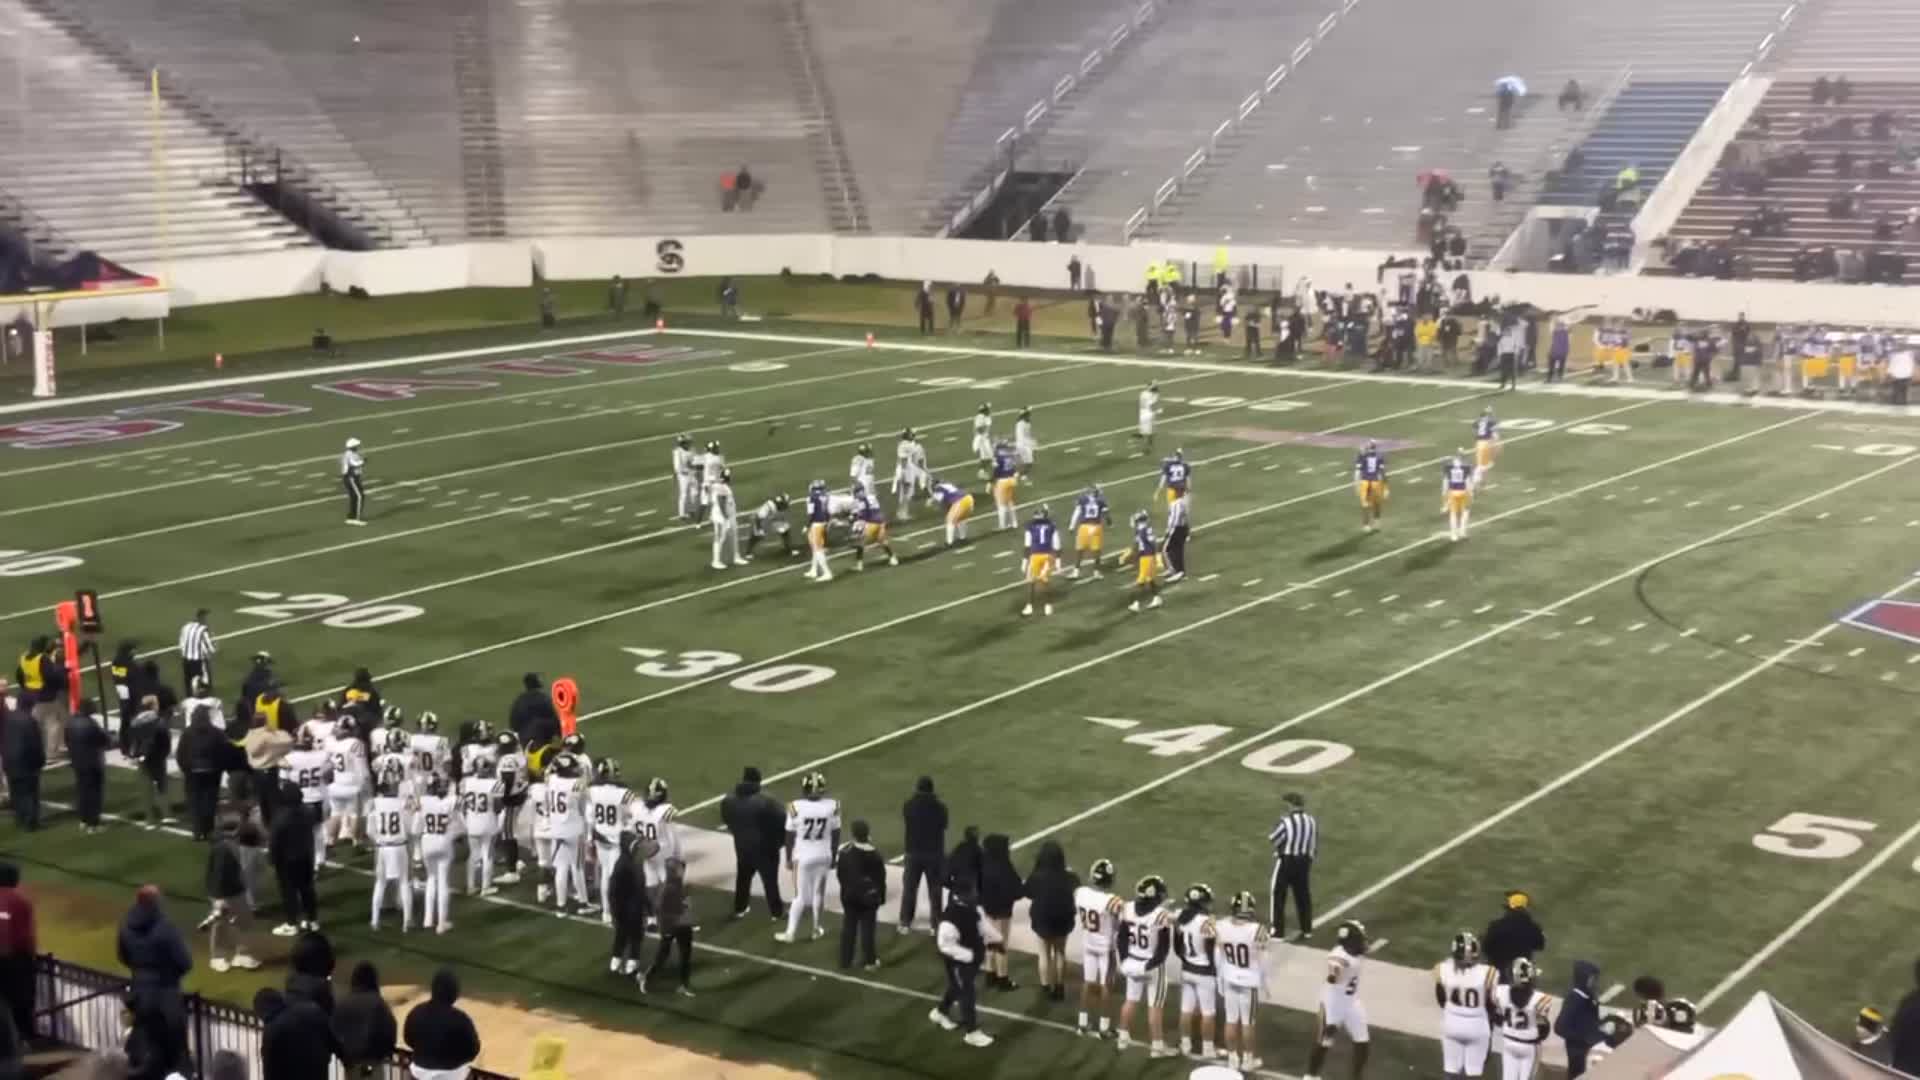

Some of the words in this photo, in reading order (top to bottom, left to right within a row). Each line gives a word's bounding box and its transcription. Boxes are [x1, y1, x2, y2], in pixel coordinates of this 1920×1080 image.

[380, 812, 400, 836] 18
[803, 817, 828, 841] 77
[1752, 812, 1879, 859] 5
